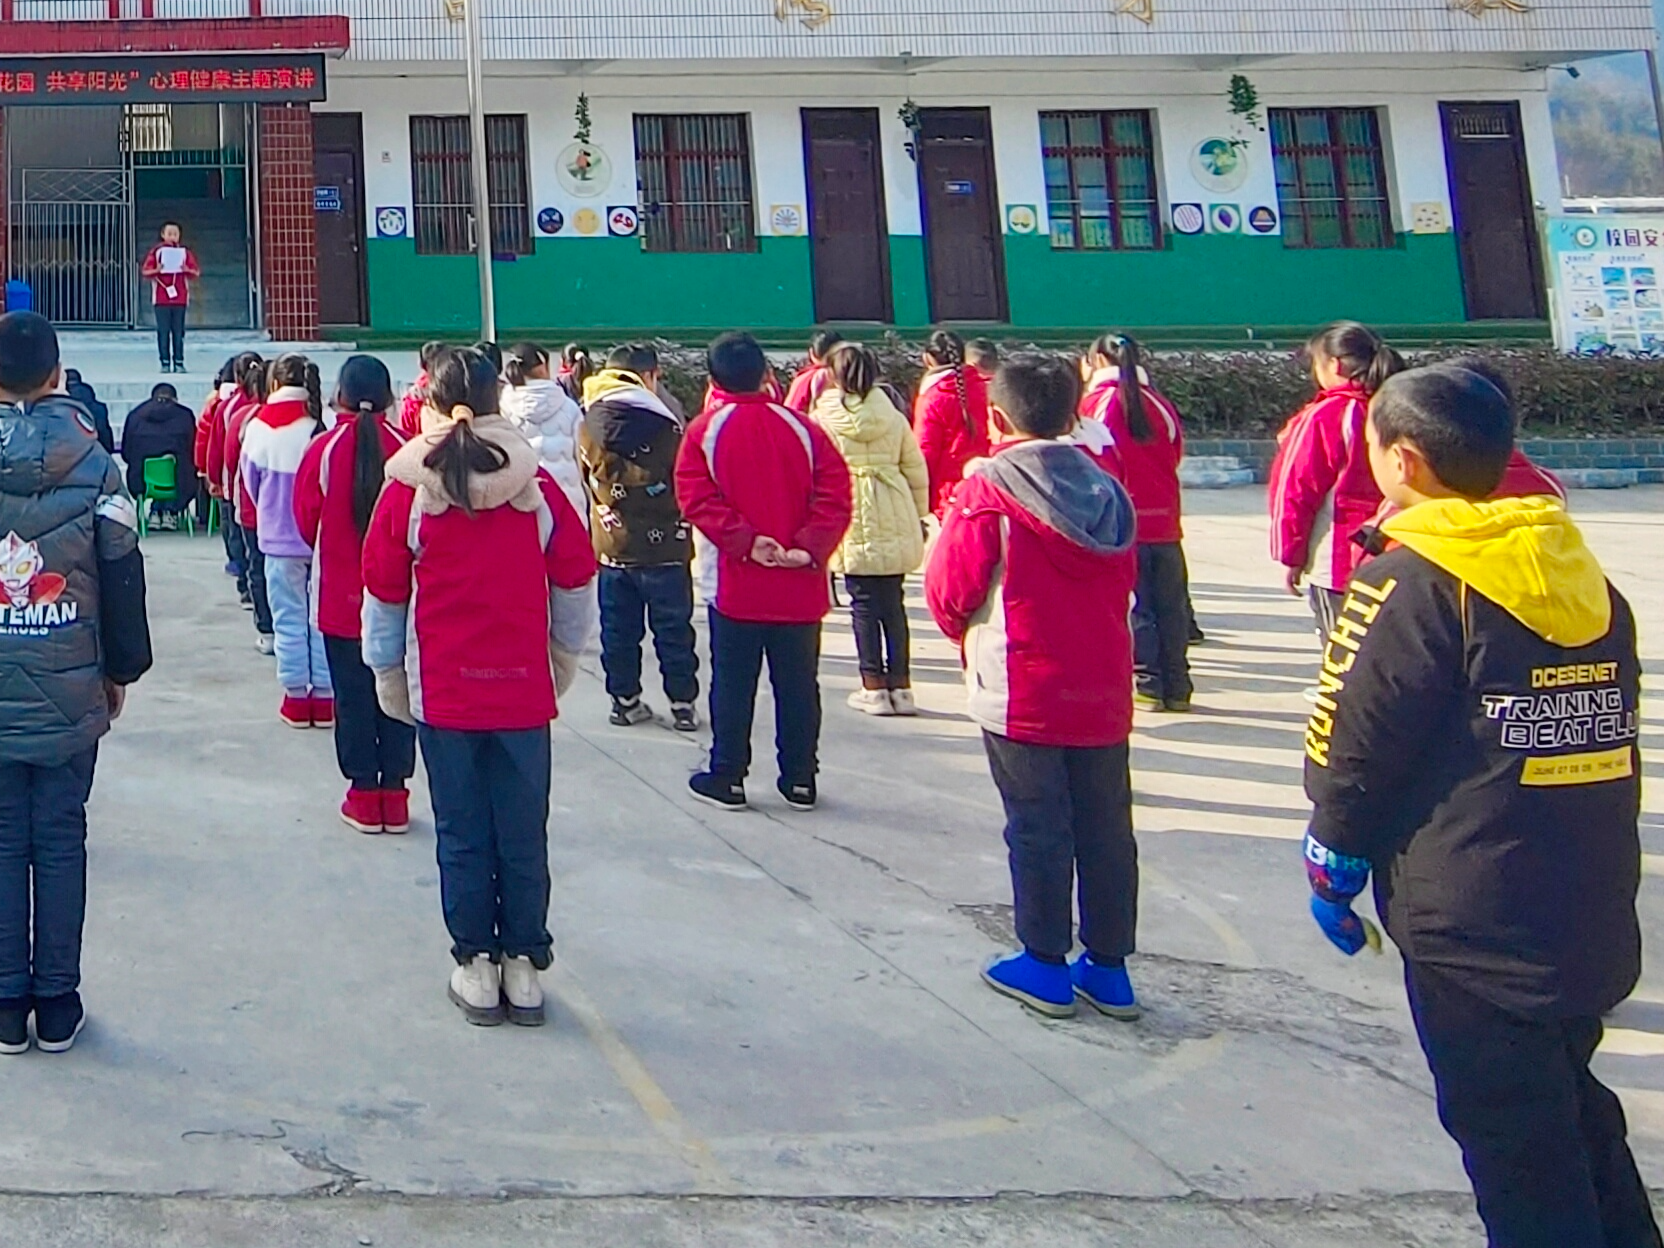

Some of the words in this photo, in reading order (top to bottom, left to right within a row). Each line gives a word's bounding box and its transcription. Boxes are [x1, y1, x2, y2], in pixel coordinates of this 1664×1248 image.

[149, 67, 315, 92] 心理健康主题演讲
[1481, 687, 1624, 721] TRAINING
[1500, 716, 1593, 749] BEAT
